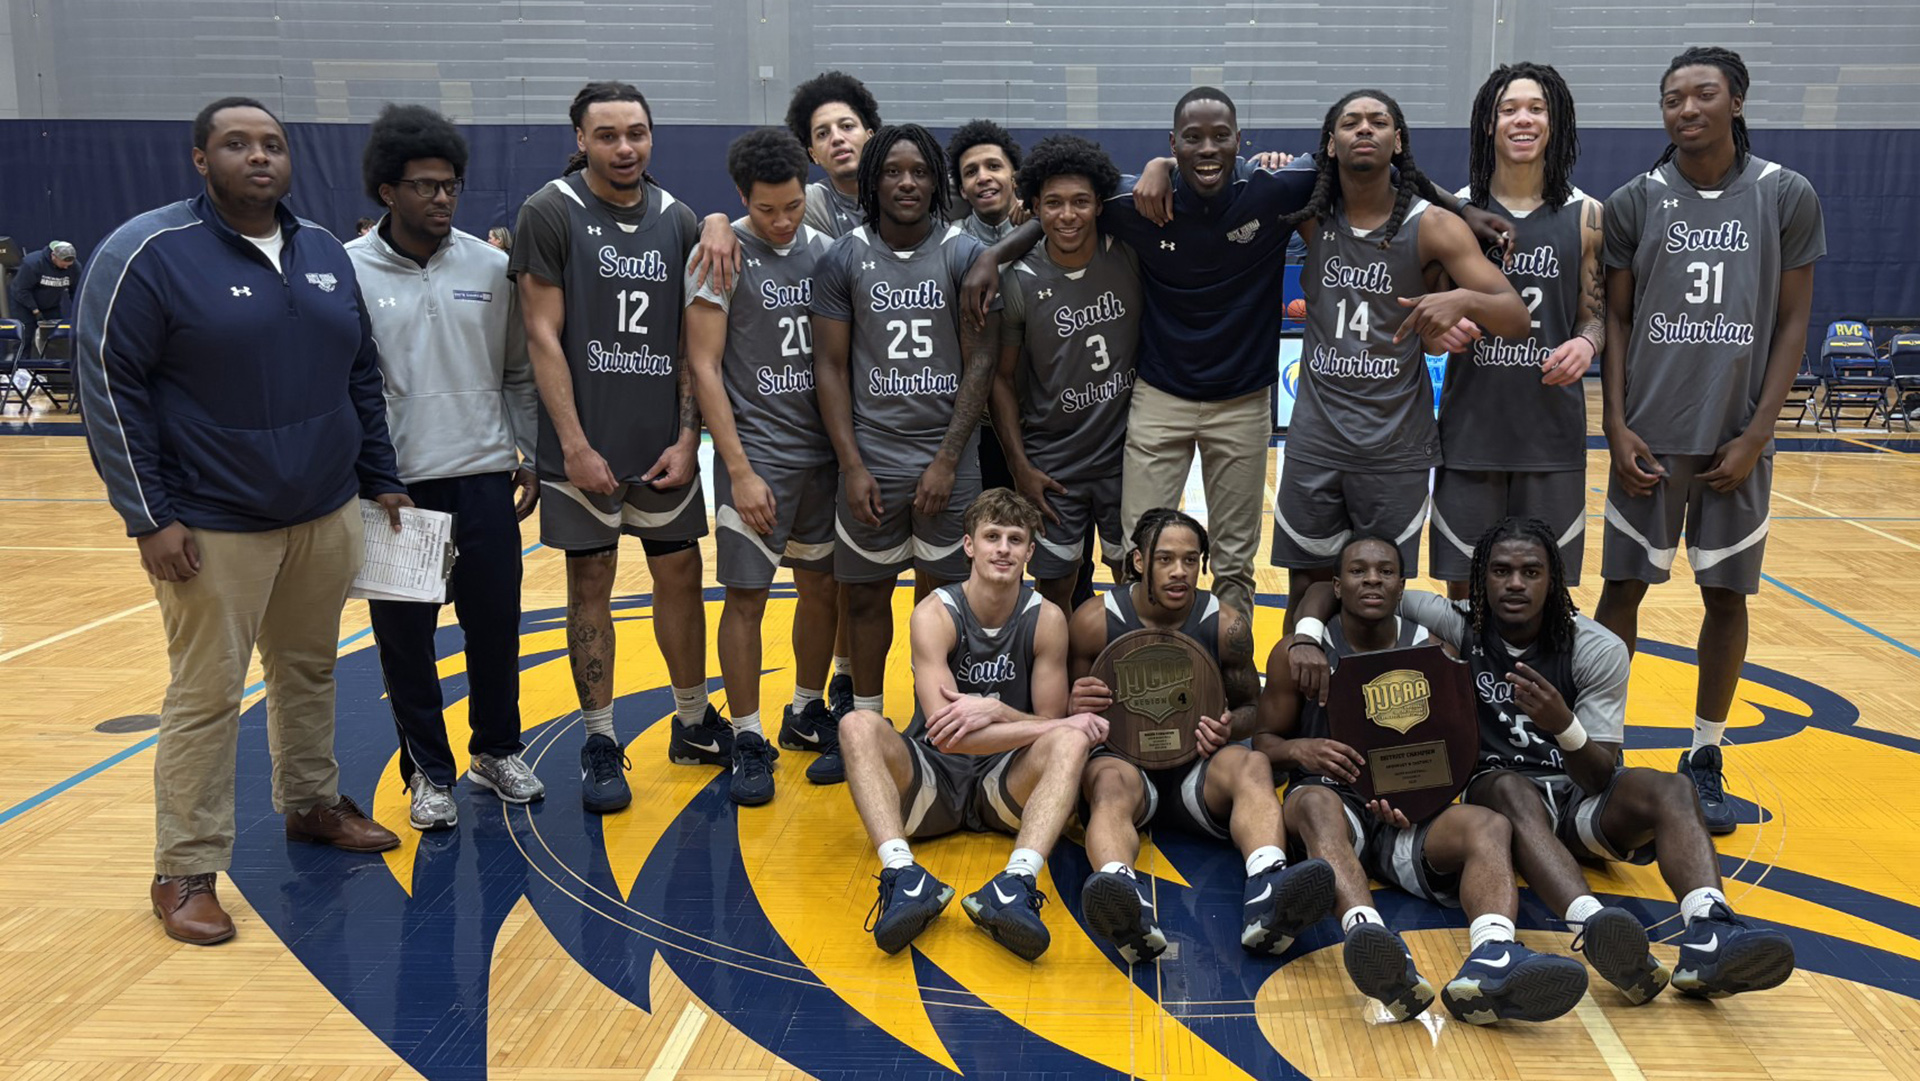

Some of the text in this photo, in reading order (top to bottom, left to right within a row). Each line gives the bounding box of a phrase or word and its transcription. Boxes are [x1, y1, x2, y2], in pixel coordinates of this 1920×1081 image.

[1666, 220, 1749, 253] South
[599, 245, 668, 281] South
[1322, 256, 1392, 294] South
[870, 280, 945, 312] South
[1685, 262, 1725, 303] 31
[616, 289, 649, 334] 12
[1055, 291, 1126, 337] South
[1335, 299, 1369, 341] 14
[1649, 313, 1753, 345] Suburban
[778, 315, 813, 357] 20
[886, 319, 933, 360] 25
[1835, 323, 1863, 337] RVC
[588, 340, 672, 375] Suburban
[1085, 334, 1111, 372] 3
[1310, 344, 1399, 379] Suburban
[1473, 336, 1559, 367] Suburba
[869, 367, 958, 396] Suburban
[1178, 692, 1187, 705] 4
[1364, 679, 1429, 716] NJCAA
